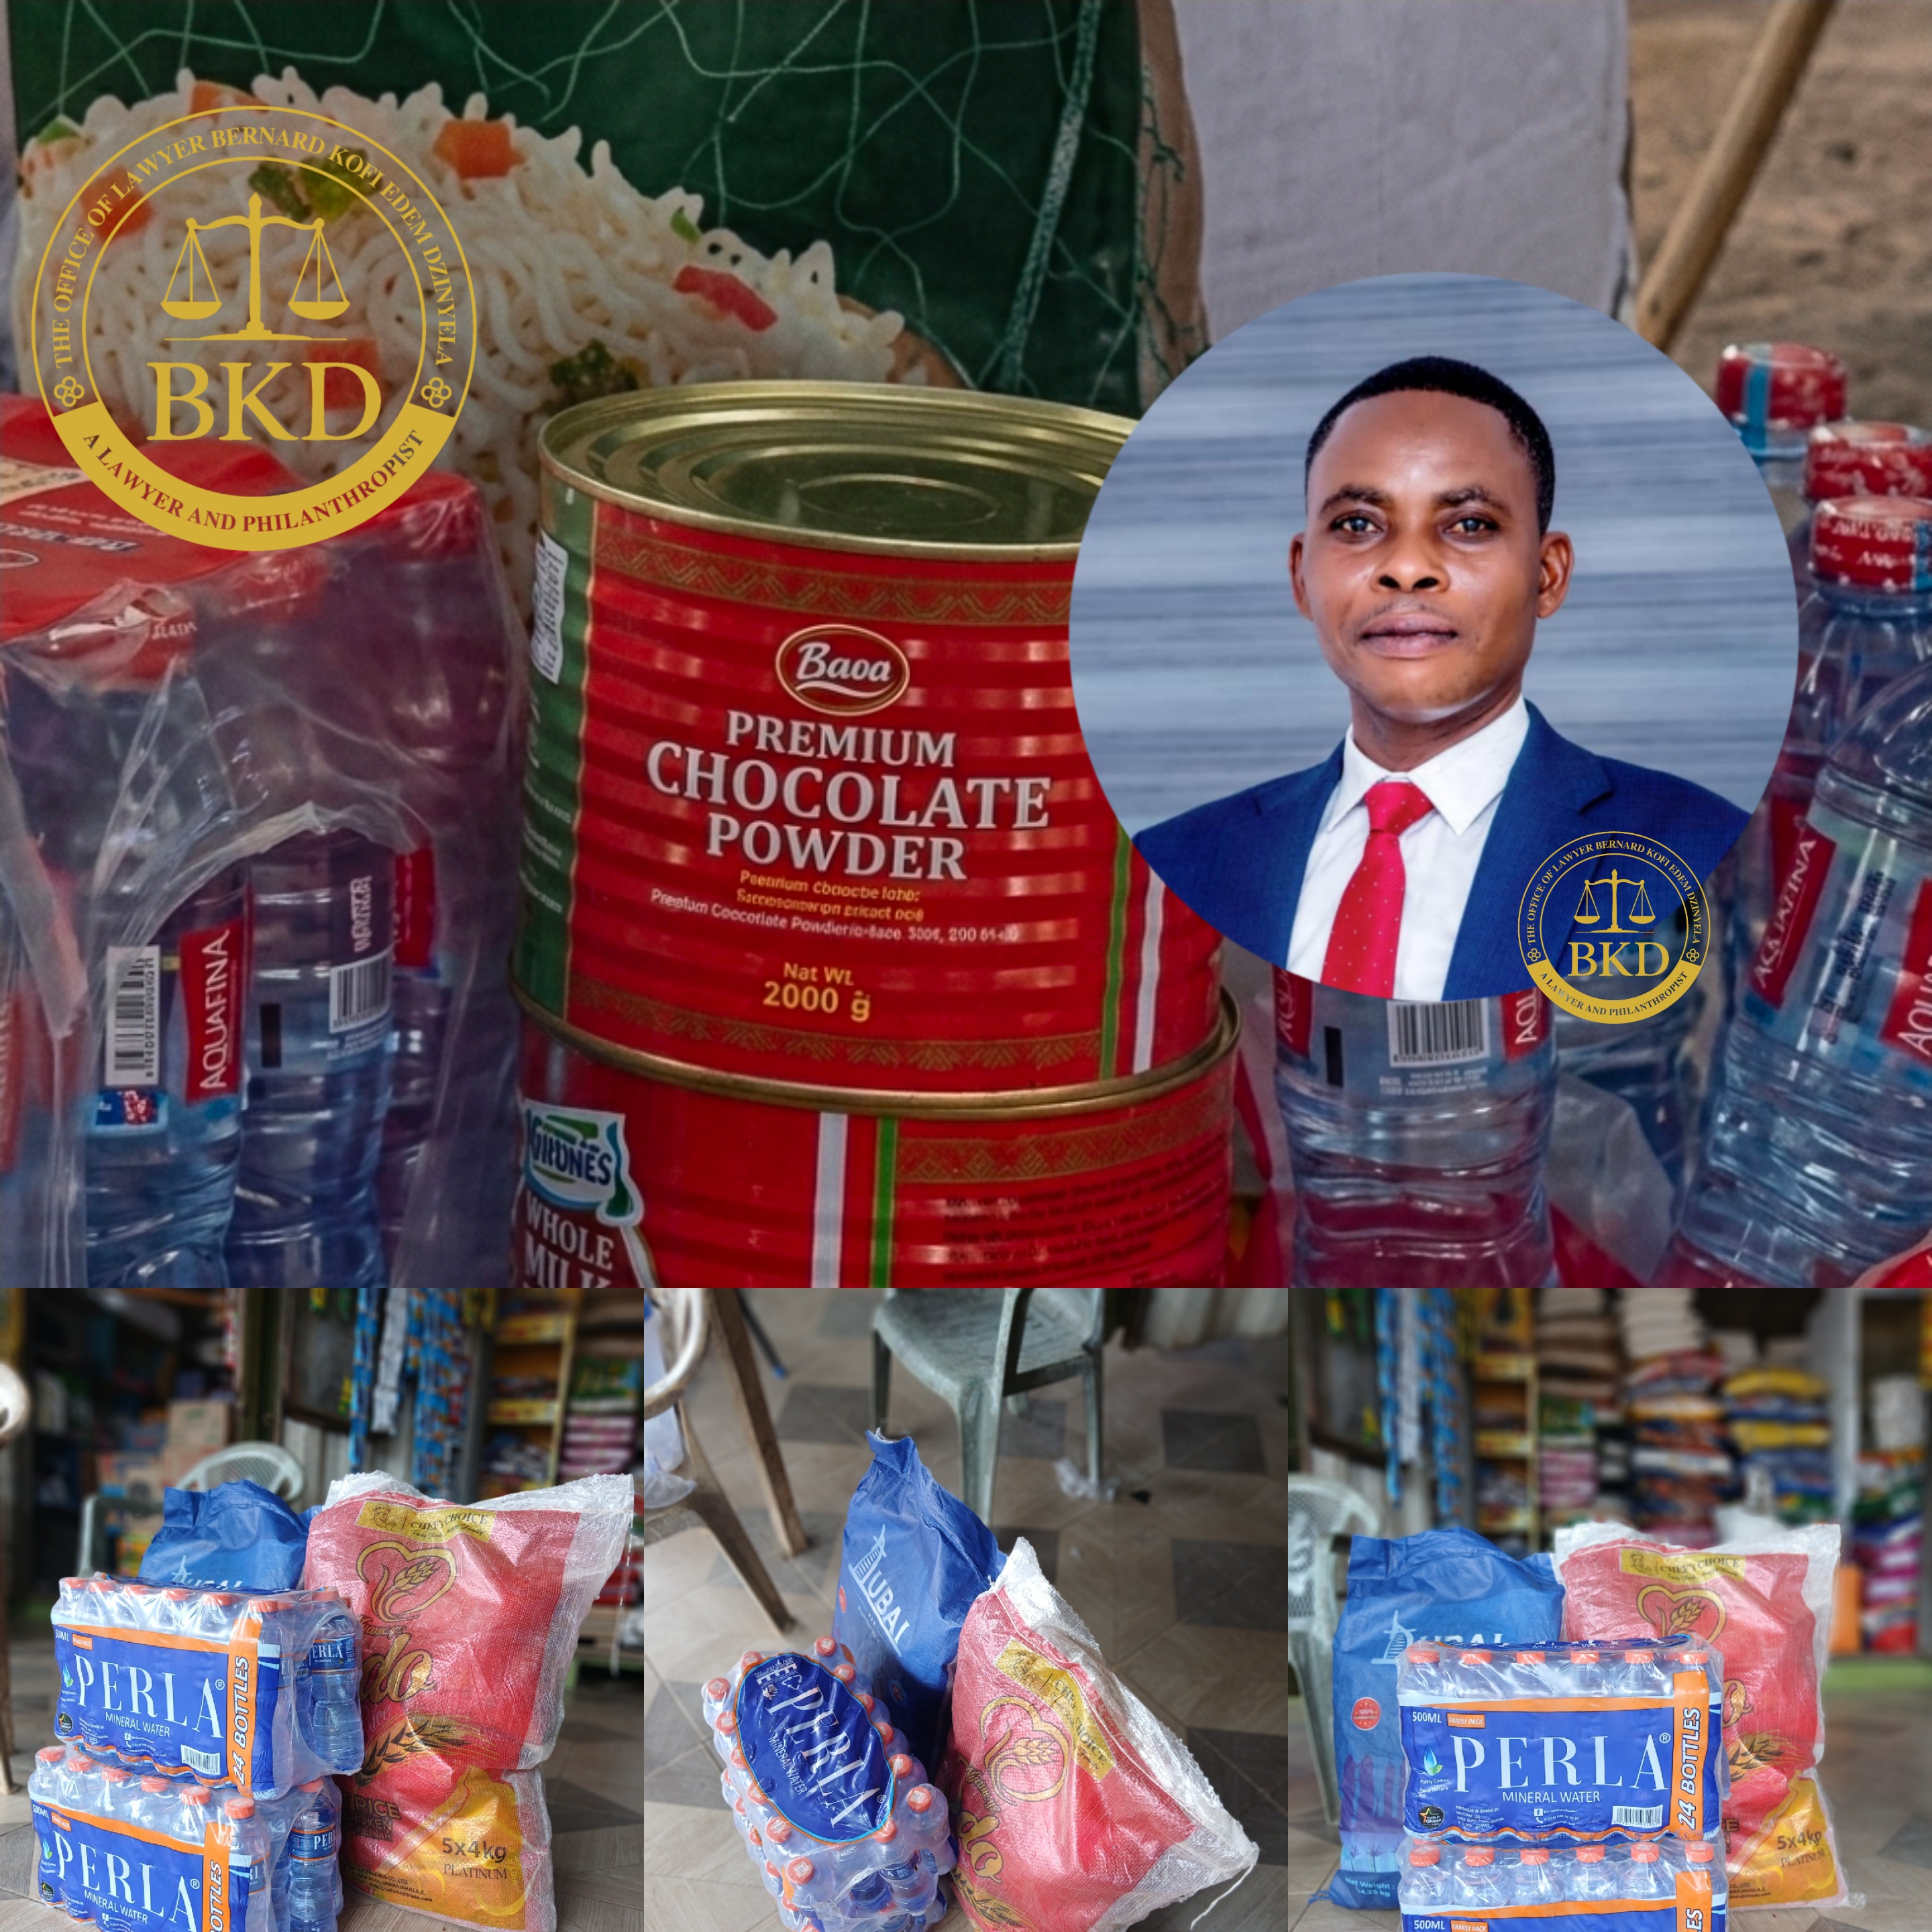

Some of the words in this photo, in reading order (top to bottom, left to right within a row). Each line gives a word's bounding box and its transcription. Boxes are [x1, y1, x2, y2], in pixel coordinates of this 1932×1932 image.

[725, 709, 956, 768] PREMIUM
[647, 741, 1052, 830] CHOCOLATE
[706, 812, 967, 881] POWDER
[783, 961, 818, 982] Nat
[200, 929, 230, 1089] AQUAFINA
[762, 980, 839, 1014] 2000
[850, 990, 871, 1023] g
[527, 1190, 614, 1271] WHOLE
[444, 1512, 488, 1525] CHOICE
[1697, 1557, 1739, 1568] CHOICE
[309, 1644, 344, 1660] ERLA
[74, 1654, 224, 1739] PERLA
[233, 1656, 249, 1750] BOTTLES
[105, 1711, 141, 1731] MINERAL
[143, 1721, 170, 1737] WATER
[1412, 1711, 1442, 1723] 500ML
[1448, 1717, 1467, 1725] FAMILY
[1468, 1717, 1484, 1725] PACK
[232, 1750, 245, 1786] 24
[765, 1684, 881, 1829] PERLA
[767, 1735, 791, 1770] MINERAL
[786, 1764, 808, 1796] WATER
[1450, 1734, 1669, 1792] PERLA
[1680, 1707, 1701, 1796] BOTTLES
[32, 1803, 49, 1819] 500ML
[354, 1795, 402, 1820] RICE
[1502, 1790, 1558, 1803] MINERAL
[1560, 1790, 1601, 1803] WATER
[1678, 1799, 1696, 1831] 24
[53, 1830, 198, 1932] PERLA
[443, 1864, 508, 1880] PLATINUM
[1359, 1880, 1391, 1890] Weight
[84, 1889, 119, 1913] MINERAL
[119, 1904, 148, 1925] WATER
[209, 1860, 223, 1932] OTTLES
[1413, 1920, 1445, 1930] 500ML
[1452, 1924, 1472, 1932] FAMILY
